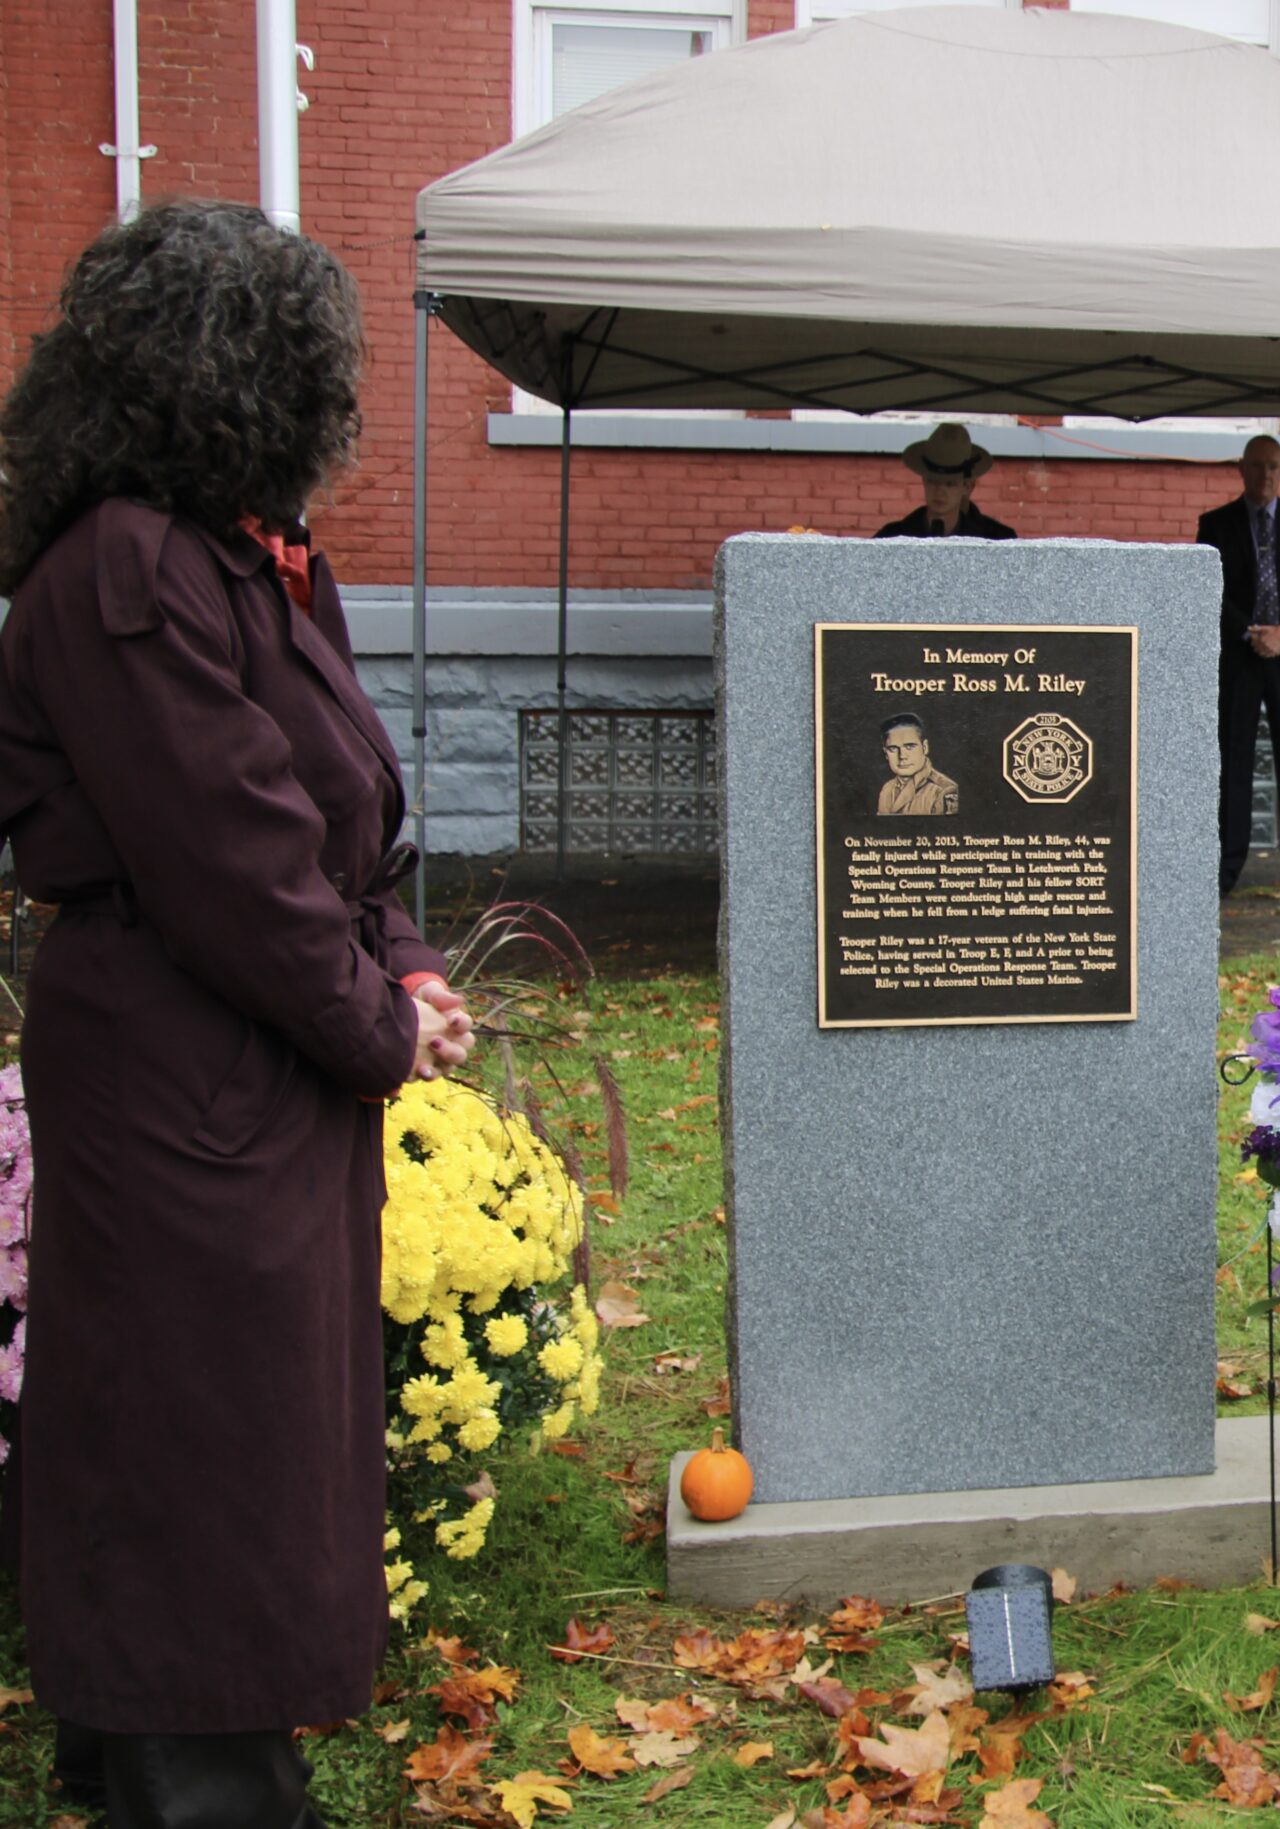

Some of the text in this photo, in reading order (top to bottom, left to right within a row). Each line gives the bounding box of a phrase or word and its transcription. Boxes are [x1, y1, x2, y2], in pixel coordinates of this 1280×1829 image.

[923, 648, 1036, 667] In Memory Of
[871, 673, 1086, 696] Trooper Ross M. Riley
[1022, 730, 1074, 748] NEW YORK
[1013, 755, 1082, 766] N Y
[1021, 772, 1075, 791] STATE POLICE
[845, 835, 1111, 848] On November 20, 2013, Trooper Ross M. Riley, 44, was
[852, 848, 1104, 863] fatally injured while participating in training with the
[848, 862, 1108, 878] Special Operations Response Team in Letchworth Park,
[851, 876, 1105, 891] Wyoming County. Trooper Riley and his fellow SORT
[850, 890, 1106, 904] Team Members were conducting high angle rescue and
[842, 909, 880, 920] training
[883, 907, 909, 918] when
[912, 907, 924, 917] he
[927, 906, 943, 917] fell
[946, 906, 968, 917] from
[981, 906, 1006, 918] ledge
[1009, 905, 1050, 917] suffering
[1052, 904, 1074, 915] fatal
[1076, 905, 1113, 916] injuries.
[839, 936, 877, 948] Trooper
[880, 935, 904, 947] Riley
[938, 935, 972, 946] 17-year
[974, 936, 1009, 944] veteran
[1012, 933, 1023, 944] of
[1026, 933, 1041, 943] the
[1044, 933, 1066, 943] New
[1069, 932, 1090, 942] York
[1093, 932, 1116, 942] State
[843, 946, 1114, 962] Police, having served in Troop E, F, and A prior to being
[840, 960, 1117, 975] selected to the Special Operations Response Team. Trooper
[875, 978, 899, 990] Riley
[903, 980, 921, 988] was
[933, 976, 978, 987] decorated
[981, 975, 1013, 986] United
[1017, 975, 1044, 986] States
[1048, 974, 1083, 985] Marine.
